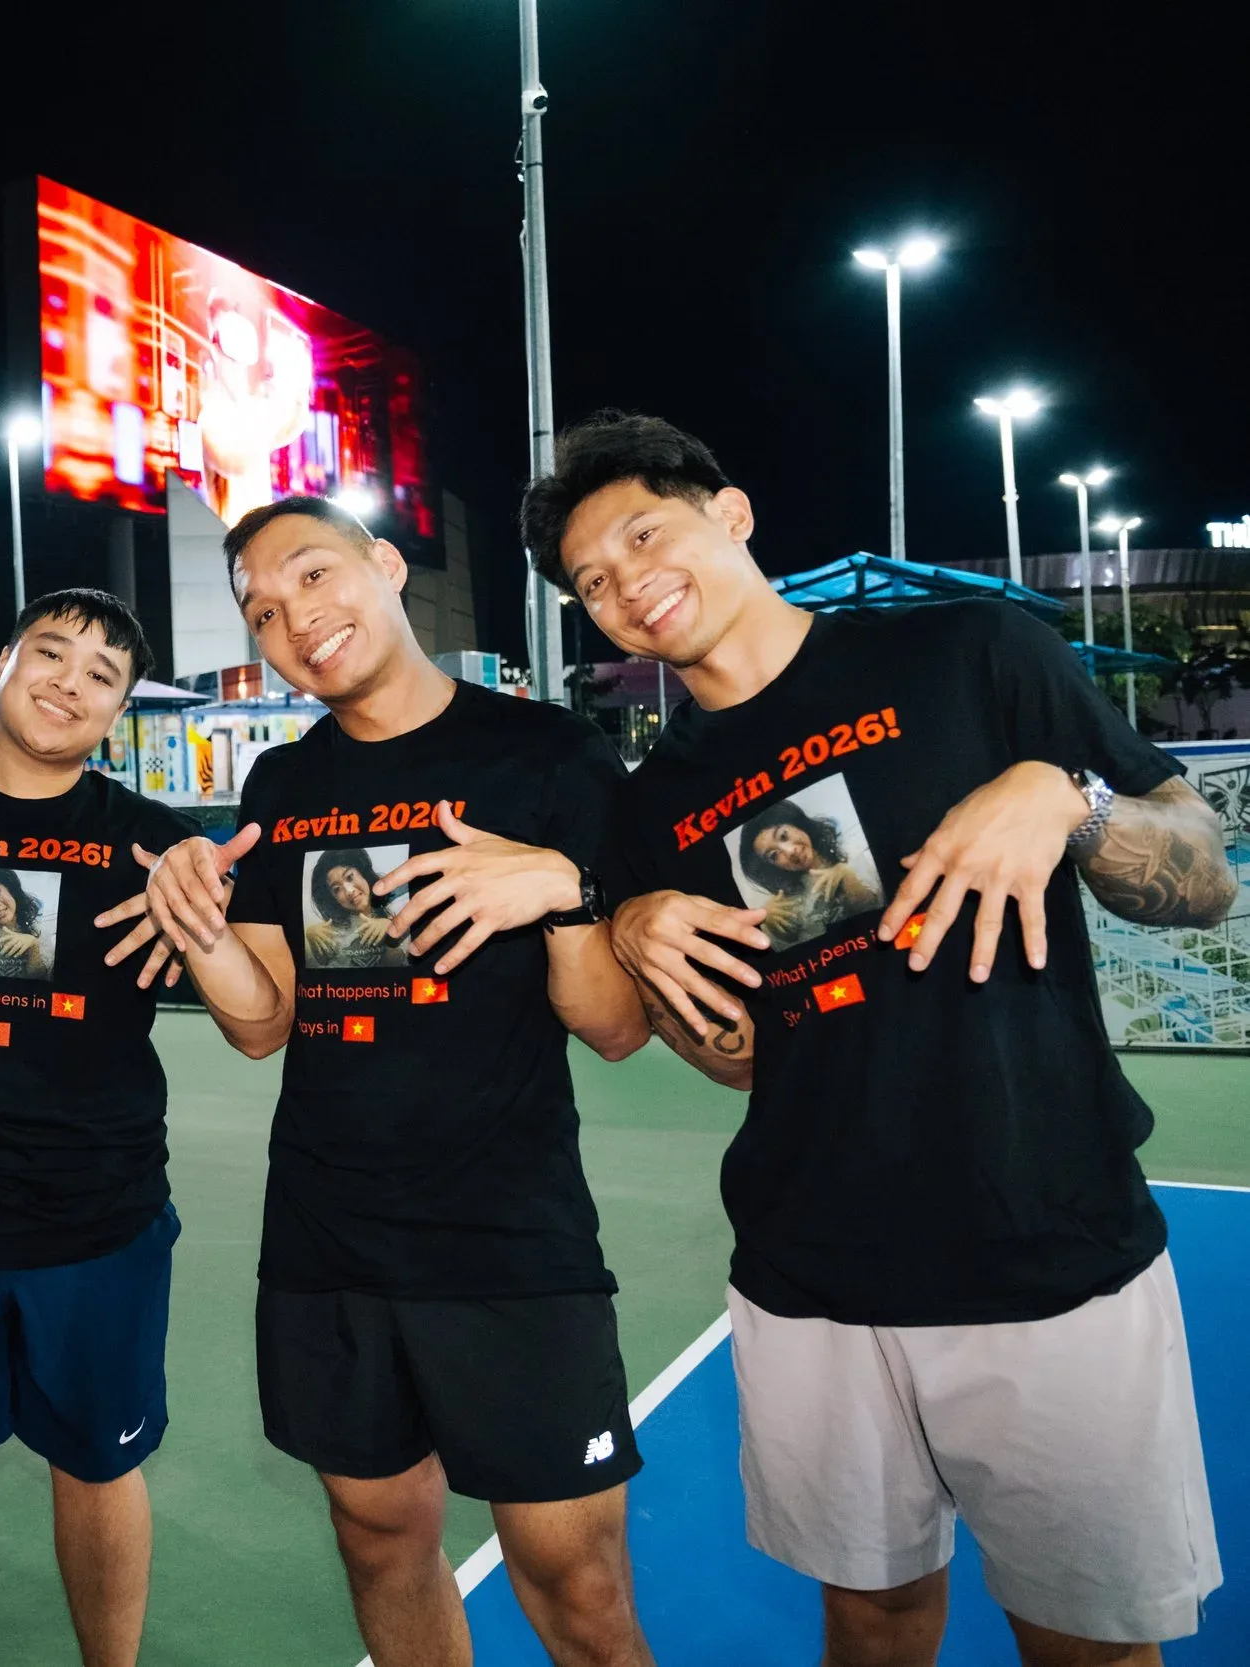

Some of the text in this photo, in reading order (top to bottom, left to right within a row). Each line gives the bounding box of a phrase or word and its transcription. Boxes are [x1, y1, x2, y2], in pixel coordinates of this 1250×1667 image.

[672, 707, 902, 852] Kevin 2026!
[272, 807, 361, 844] Kevin
[17, 837, 113, 869] 2026!
[32, 994, 47, 1010] in
[297, 982, 408, 1002] hat happens in
[297, 1019, 340, 1038] ays in
